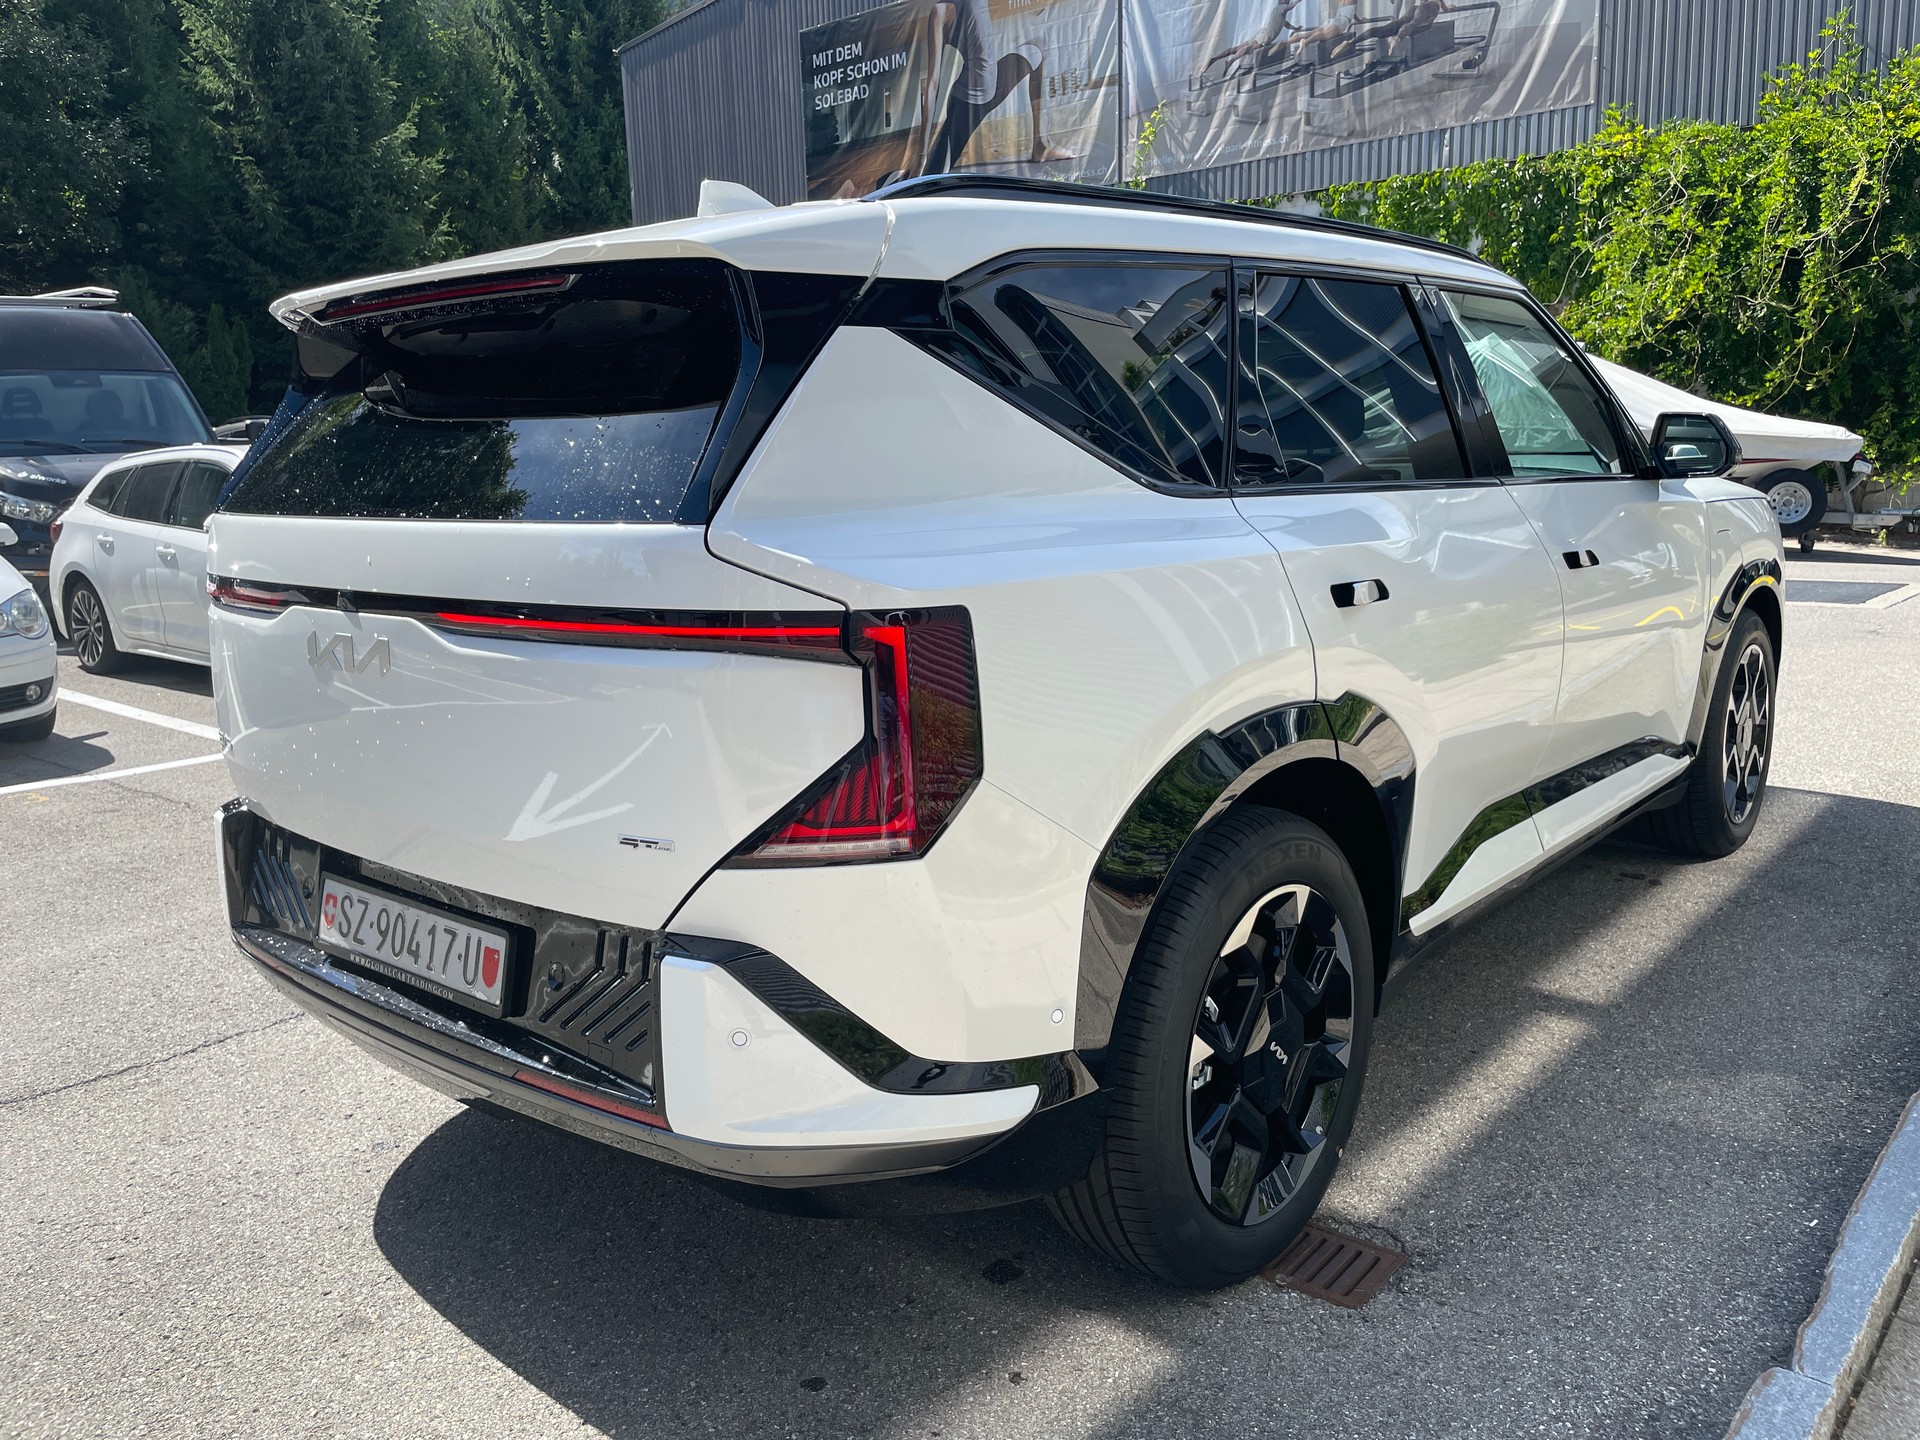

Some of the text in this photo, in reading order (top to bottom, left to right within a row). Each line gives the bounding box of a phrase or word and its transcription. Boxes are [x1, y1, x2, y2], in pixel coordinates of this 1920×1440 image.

[812, 41, 862, 69] MIT DEM
[813, 51, 907, 89] KOPF SCHON IM
[814, 83, 869, 110] SOLEBAD
[307, 631, 391, 678] KIA
[1247, 842, 1322, 885] NEXEN
